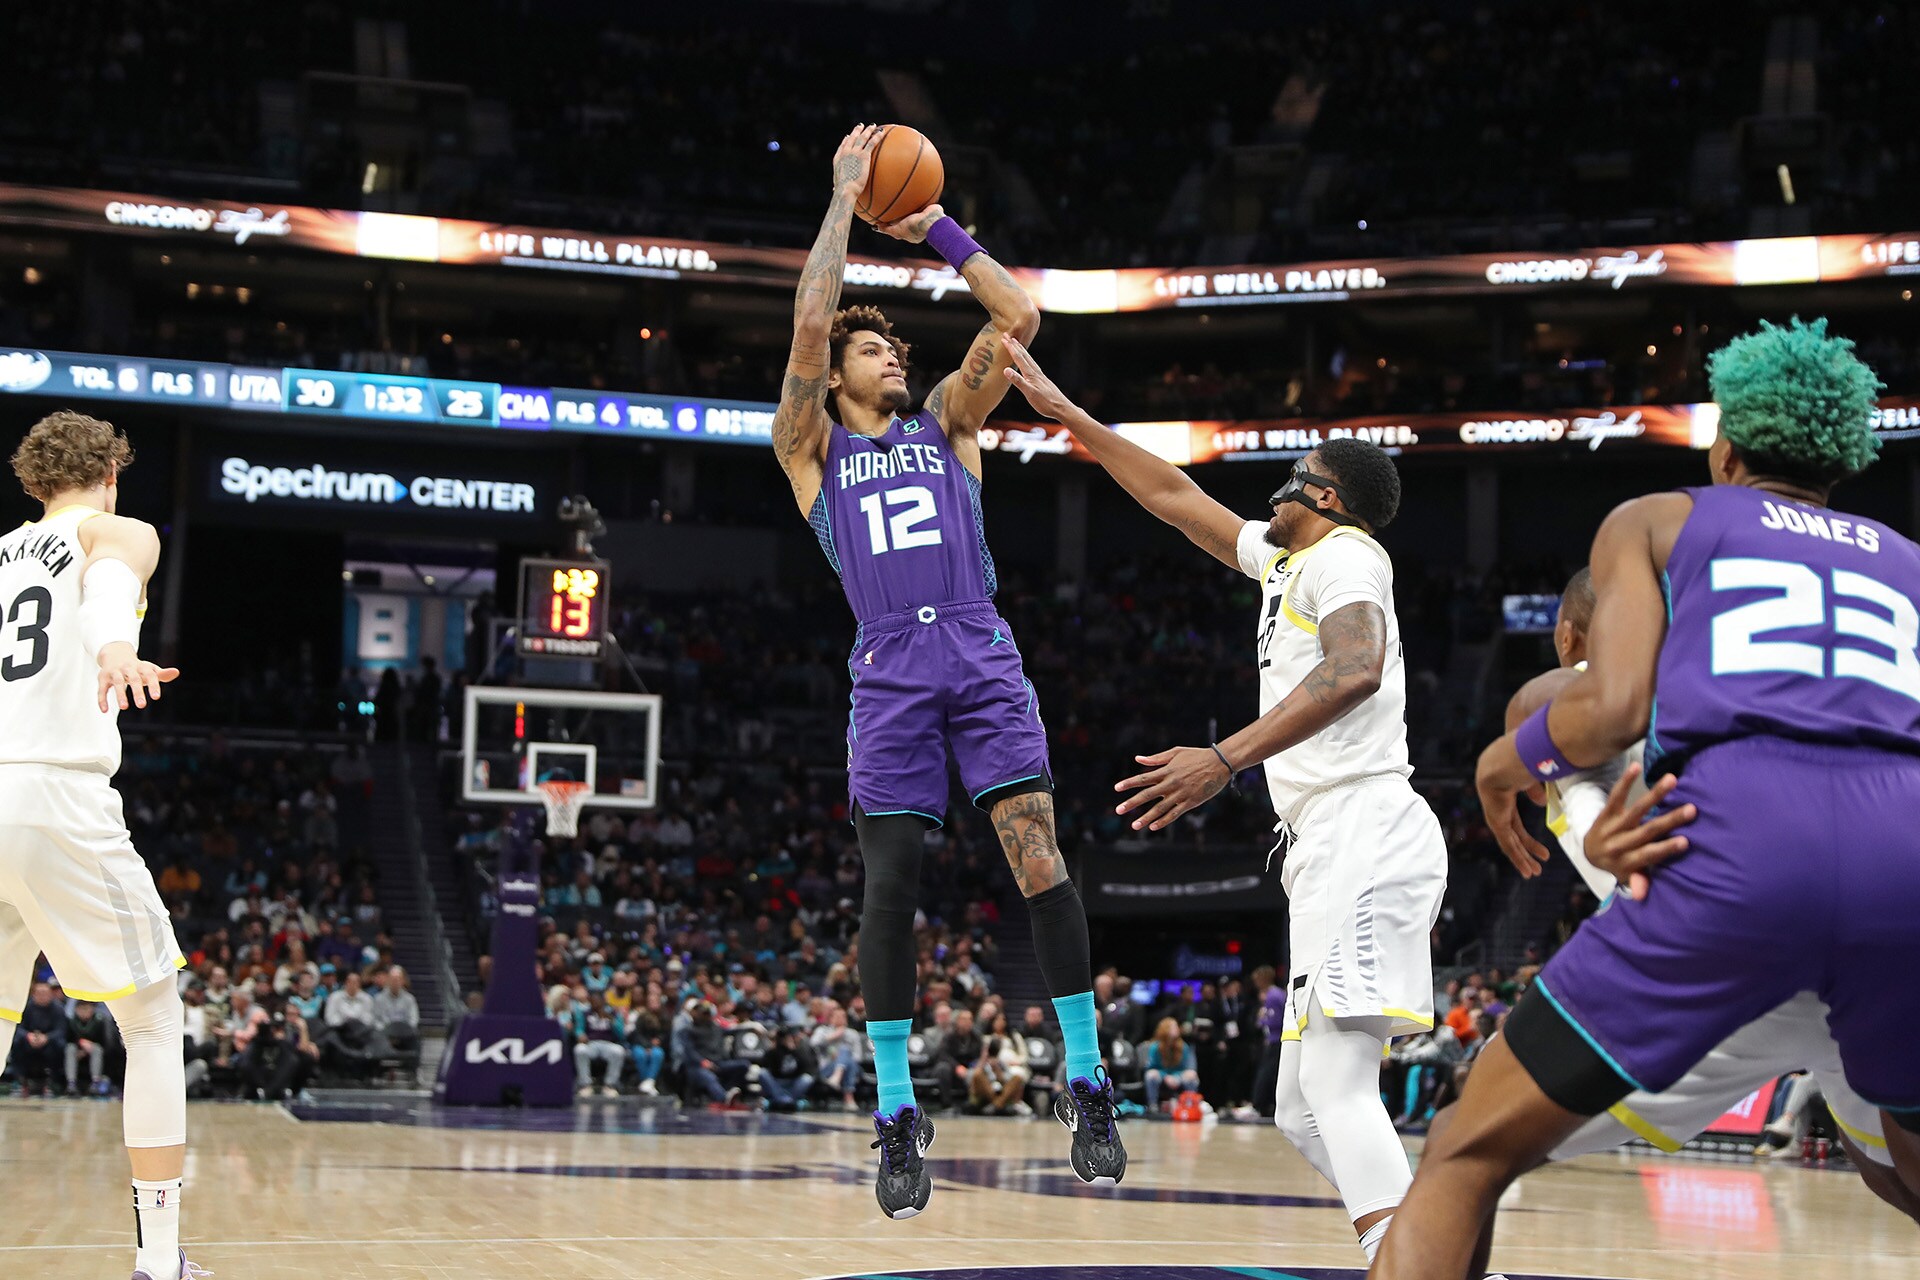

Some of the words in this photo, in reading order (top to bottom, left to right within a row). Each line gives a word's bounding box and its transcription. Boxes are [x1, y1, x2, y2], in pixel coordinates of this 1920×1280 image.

[479, 231, 535, 256] LIFE
[541, 236, 609, 263] WELL
[616, 243, 718, 272] PLAYED.
[1861, 241, 1920, 264] LIFE
[1154, 275, 1207, 296] LIFE
[1213, 272, 1279, 295] WELL
[1285, 267, 1386, 292] PLAYED.
[69, 365, 115, 391] TOL
[117, 368, 139, 393] 6
[151, 371, 194, 396] FLS
[203, 373, 216, 398] 1
[229, 374, 282, 404] UTA
[296, 378, 335, 407] 30
[362, 384, 423, 414] 1:32
[446, 389, 484, 418] 25
[498, 392, 551, 421] CHA
[555, 401, 596, 425] FLS
[600, 402, 621, 427] 4
[626, 406, 670, 430] TOL
[676, 407, 698, 432] 6
[1212, 431, 1260, 450] LIFE
[1264, 428, 1323, 449] WELL
[220, 457, 396, 503] Spectrum
[409, 476, 535, 513] CENTER
[836, 443, 946, 490] HORNETS
[859, 485, 943, 556] 12
[1760, 500, 1880, 554] JONES
[550, 594, 591, 637] 13
[1710, 557, 1920, 704] 23
[464, 1037, 563, 1065] KIA
